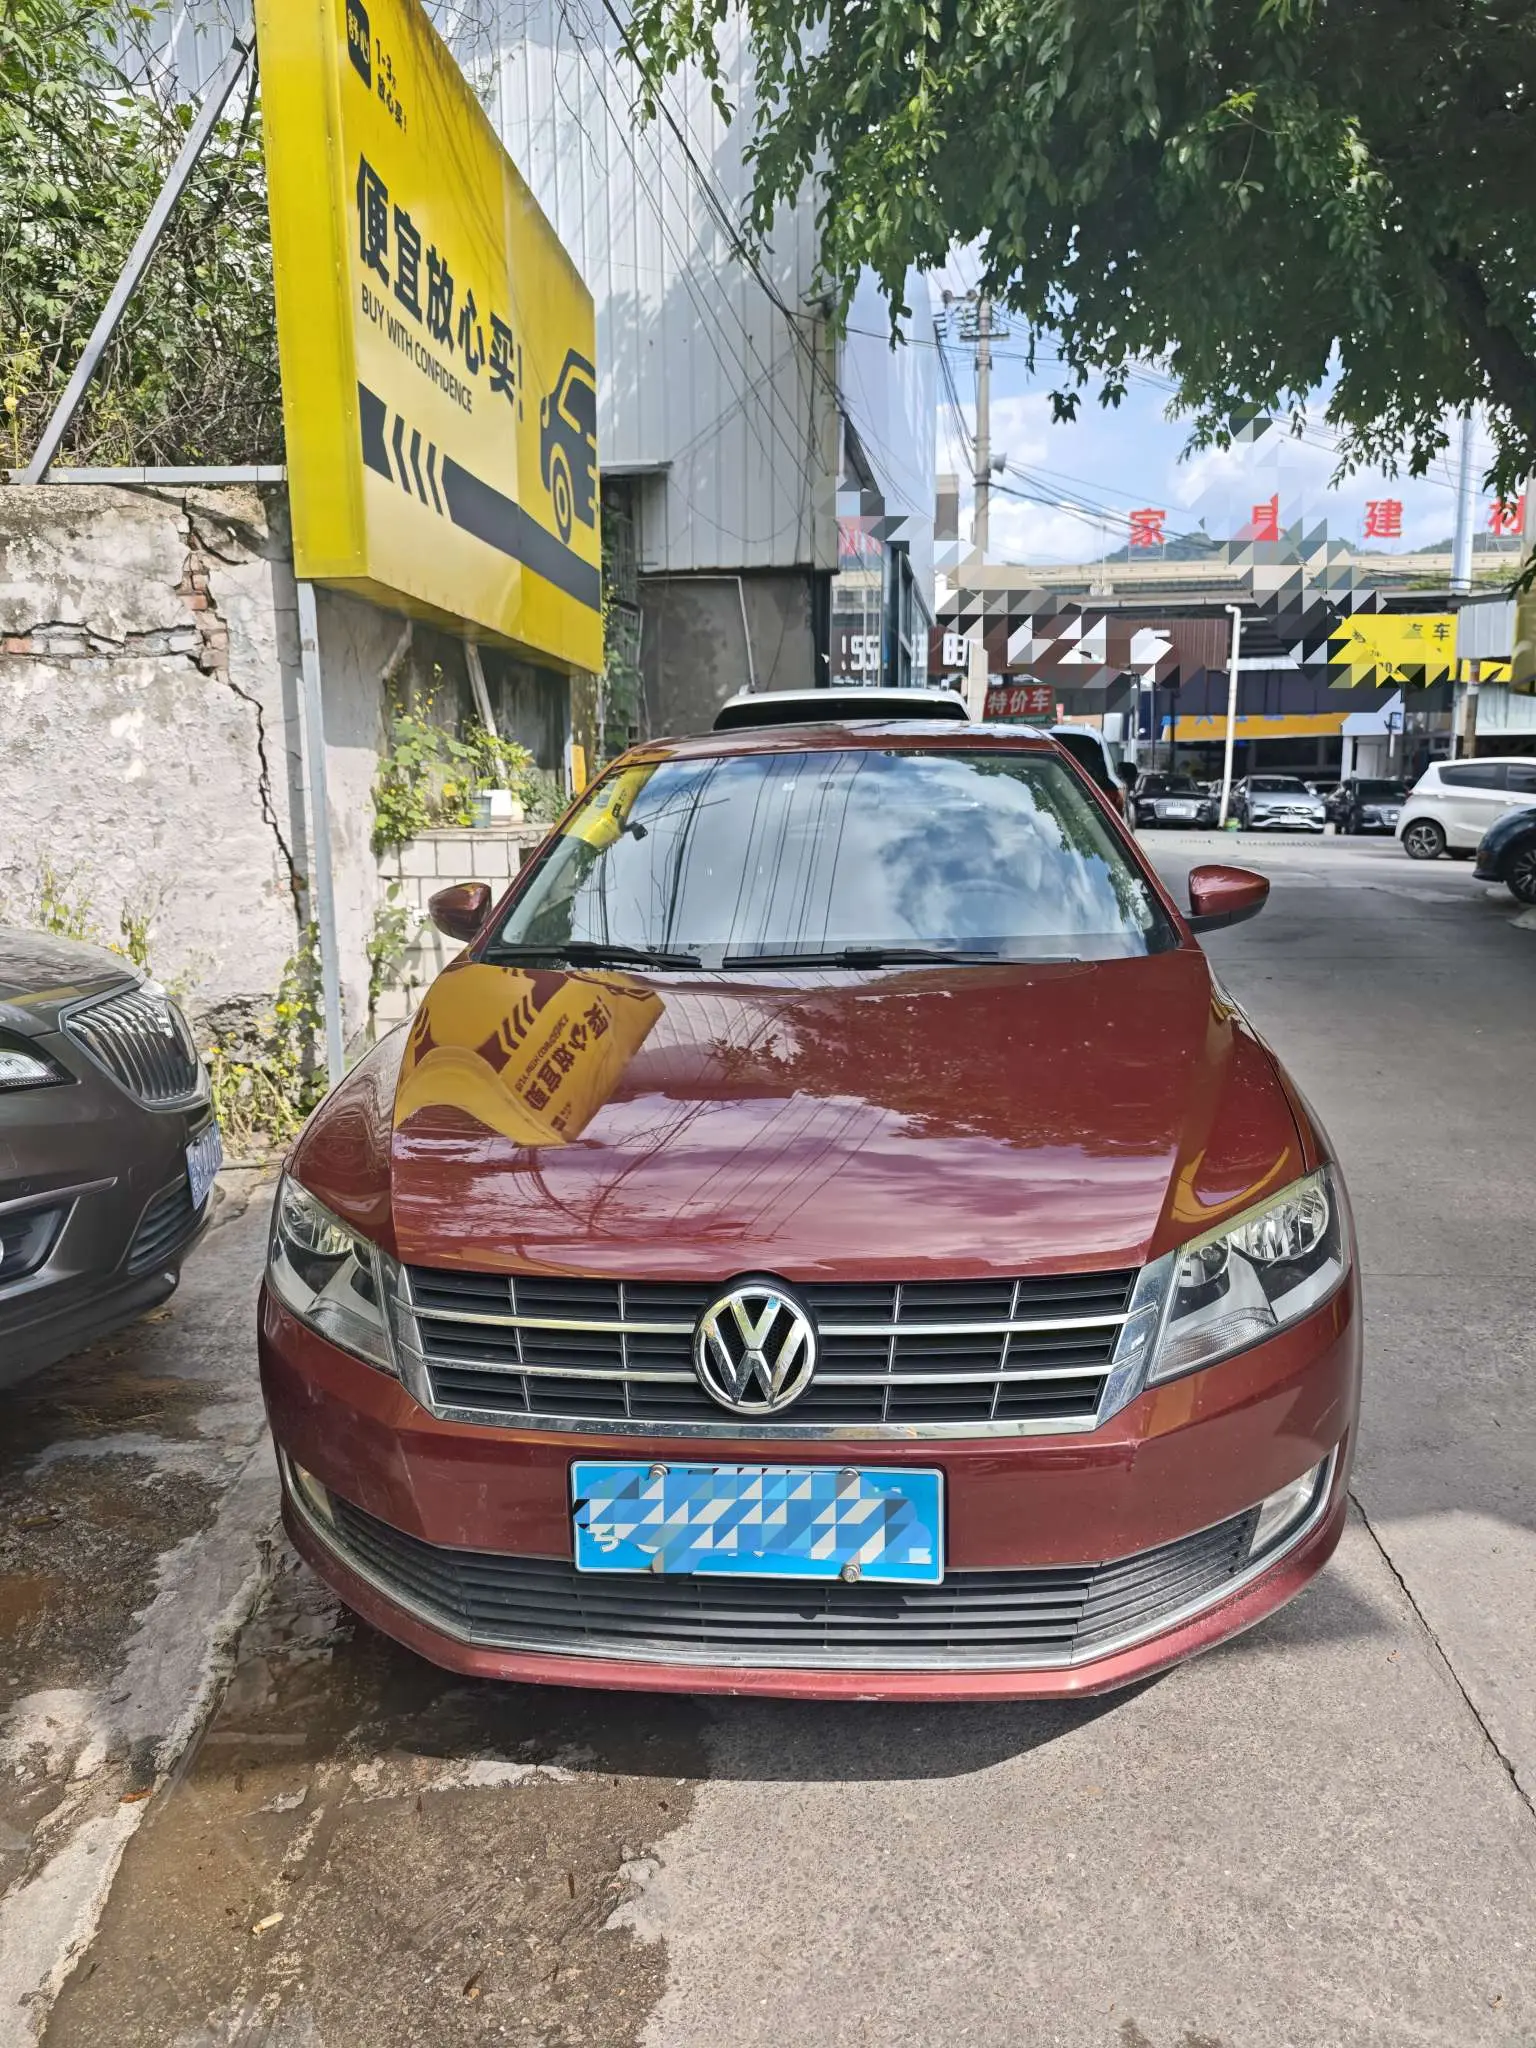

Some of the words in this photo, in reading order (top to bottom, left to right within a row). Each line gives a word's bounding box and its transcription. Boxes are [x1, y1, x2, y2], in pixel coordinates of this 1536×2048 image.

[356, 152, 524, 423] 便宜放心买!
[361, 283, 385, 331] BUY
[386, 310, 414, 361] WITH
[414, 341, 473, 415] CONFIDENCE
[987, 688, 1052, 715] 特价车
